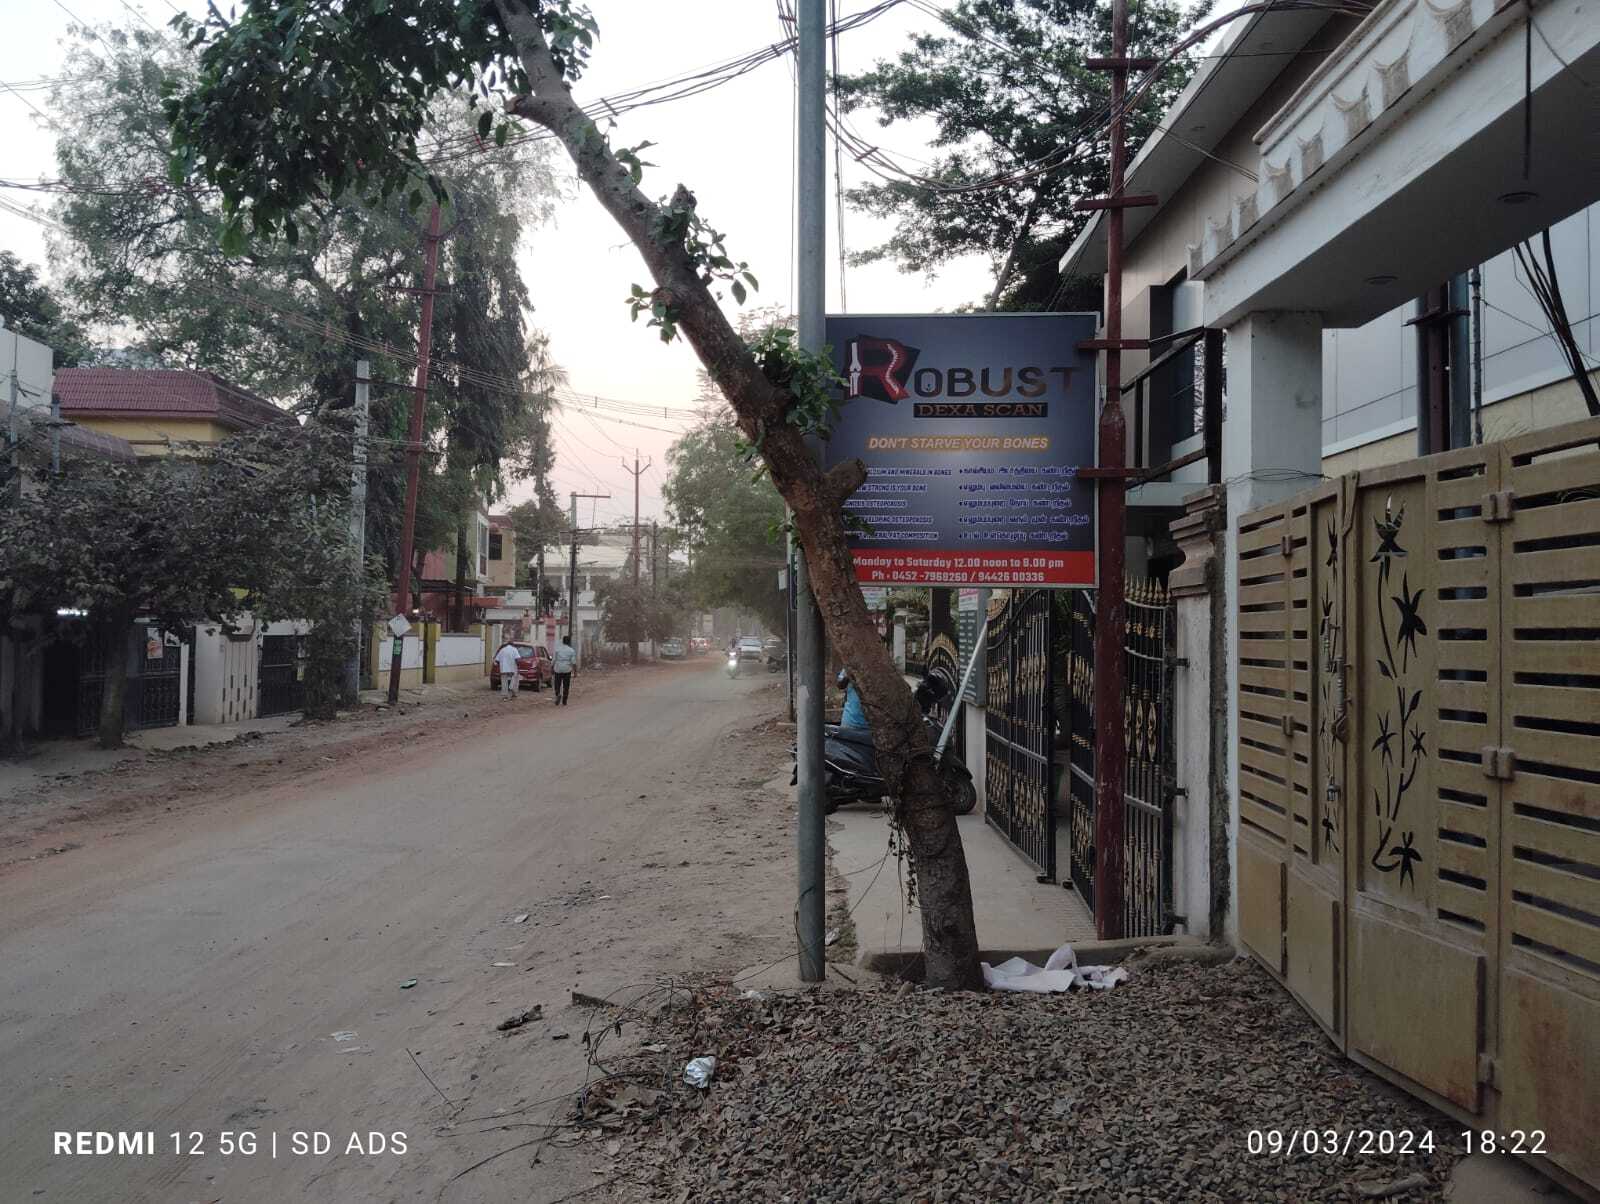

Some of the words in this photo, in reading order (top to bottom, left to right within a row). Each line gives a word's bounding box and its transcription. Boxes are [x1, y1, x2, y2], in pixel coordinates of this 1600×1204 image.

[844, 336, 1078, 402] ROBUST
[918, 403, 977, 417] DEXA
[983, 403, 1044, 417] SCAN
[868, 437, 909, 449] DON'T
[910, 437, 962, 449] STARVE
[963, 437, 1001, 449] YOUR
[1002, 437, 1049, 449] BONES
[853, 557, 892, 569] Monday
[893, 557, 905, 567] to
[906, 556, 952, 569] Saturday
[953, 557, 981, 568] 12.00
[982, 558, 1009, 568] noon
[1009, 557, 1021, 568] to
[1047, 559, 1065, 569] pm
[871, 569, 885, 581] Ph
[892, 570, 918, 581] 0452
[977, 571, 1010, 582] 94426
[1012, 571, 1045, 582] 00336
